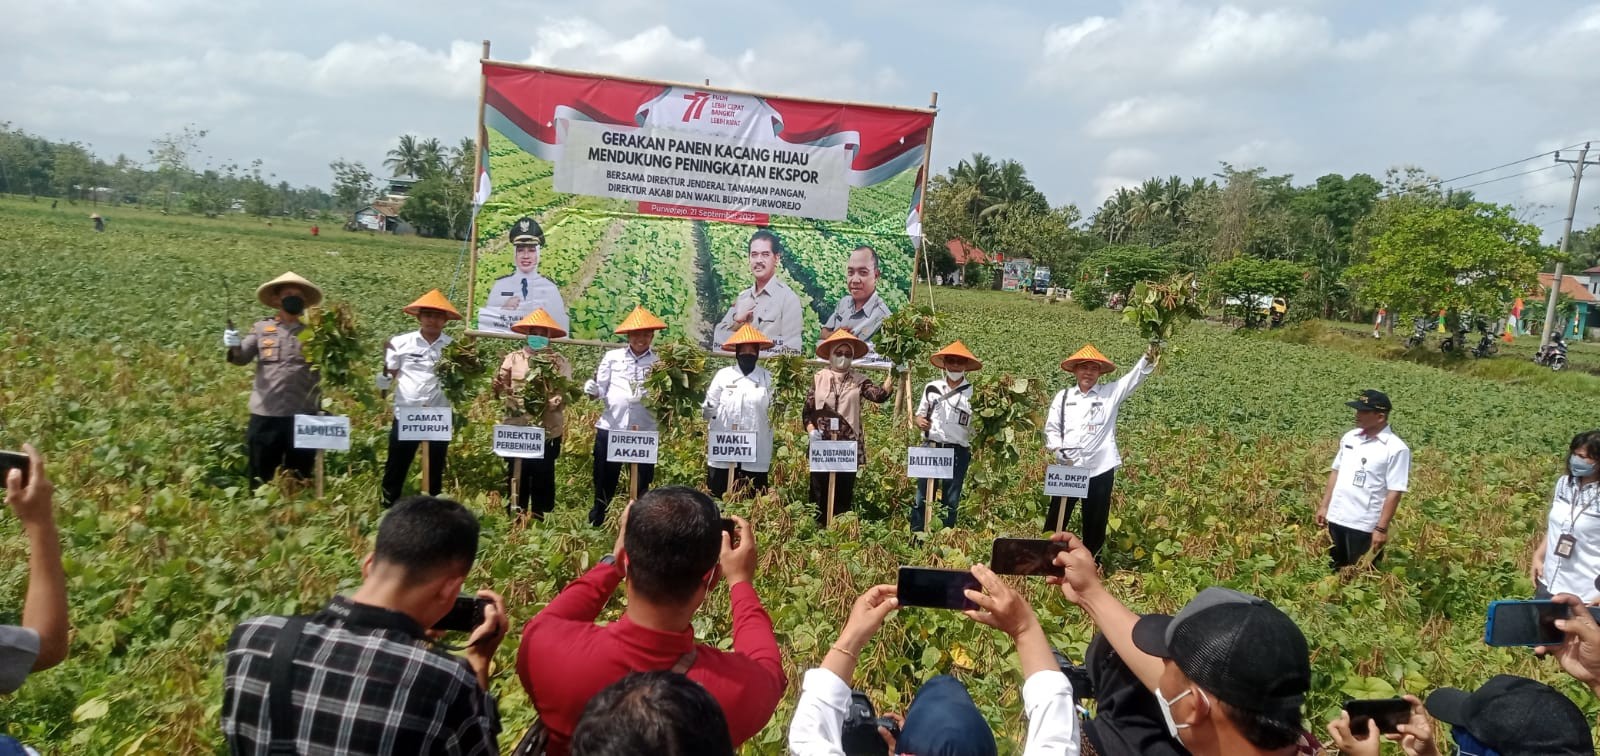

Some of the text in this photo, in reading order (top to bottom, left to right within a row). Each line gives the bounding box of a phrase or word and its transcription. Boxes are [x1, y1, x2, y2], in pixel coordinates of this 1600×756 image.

[682, 91, 711, 123] 77
[727, 103, 744, 111] CEPAT
[711, 109, 735, 117] BANGKIT
[602, 131, 809, 166] GERAKAN PANEN KACANG HIJAU
[588, 147, 819, 184] MENDUKUNG PENINGKATAN EKSPOR
[606, 170, 807, 200] BERSAMA DIREKTUR JENDERAL TANAMAN PANGAN,
[608, 183, 802, 211] DIREKTUR AKABI DAN WAKIL BUPATI PURWOREJO
[699, 210, 738, 220] September
[407, 413, 444, 422] CAMAT
[296, 424, 347, 437] KAPOLSEK
[402, 424, 449, 432] PITURUH
[497, 430, 542, 441] DIREKTUR
[611, 435, 655, 446] DIREKTUR
[716, 435, 750, 445] WAKIL
[496, 441, 542, 452] PERBENIHAN
[712, 446, 752, 456] BUPATI
[614, 449, 650, 458] AKABI
[823, 449, 855, 457] DISTANBUN
[909, 455, 952, 466] BALITKABI
[1048, 473, 1088, 482] KA. DKPP
